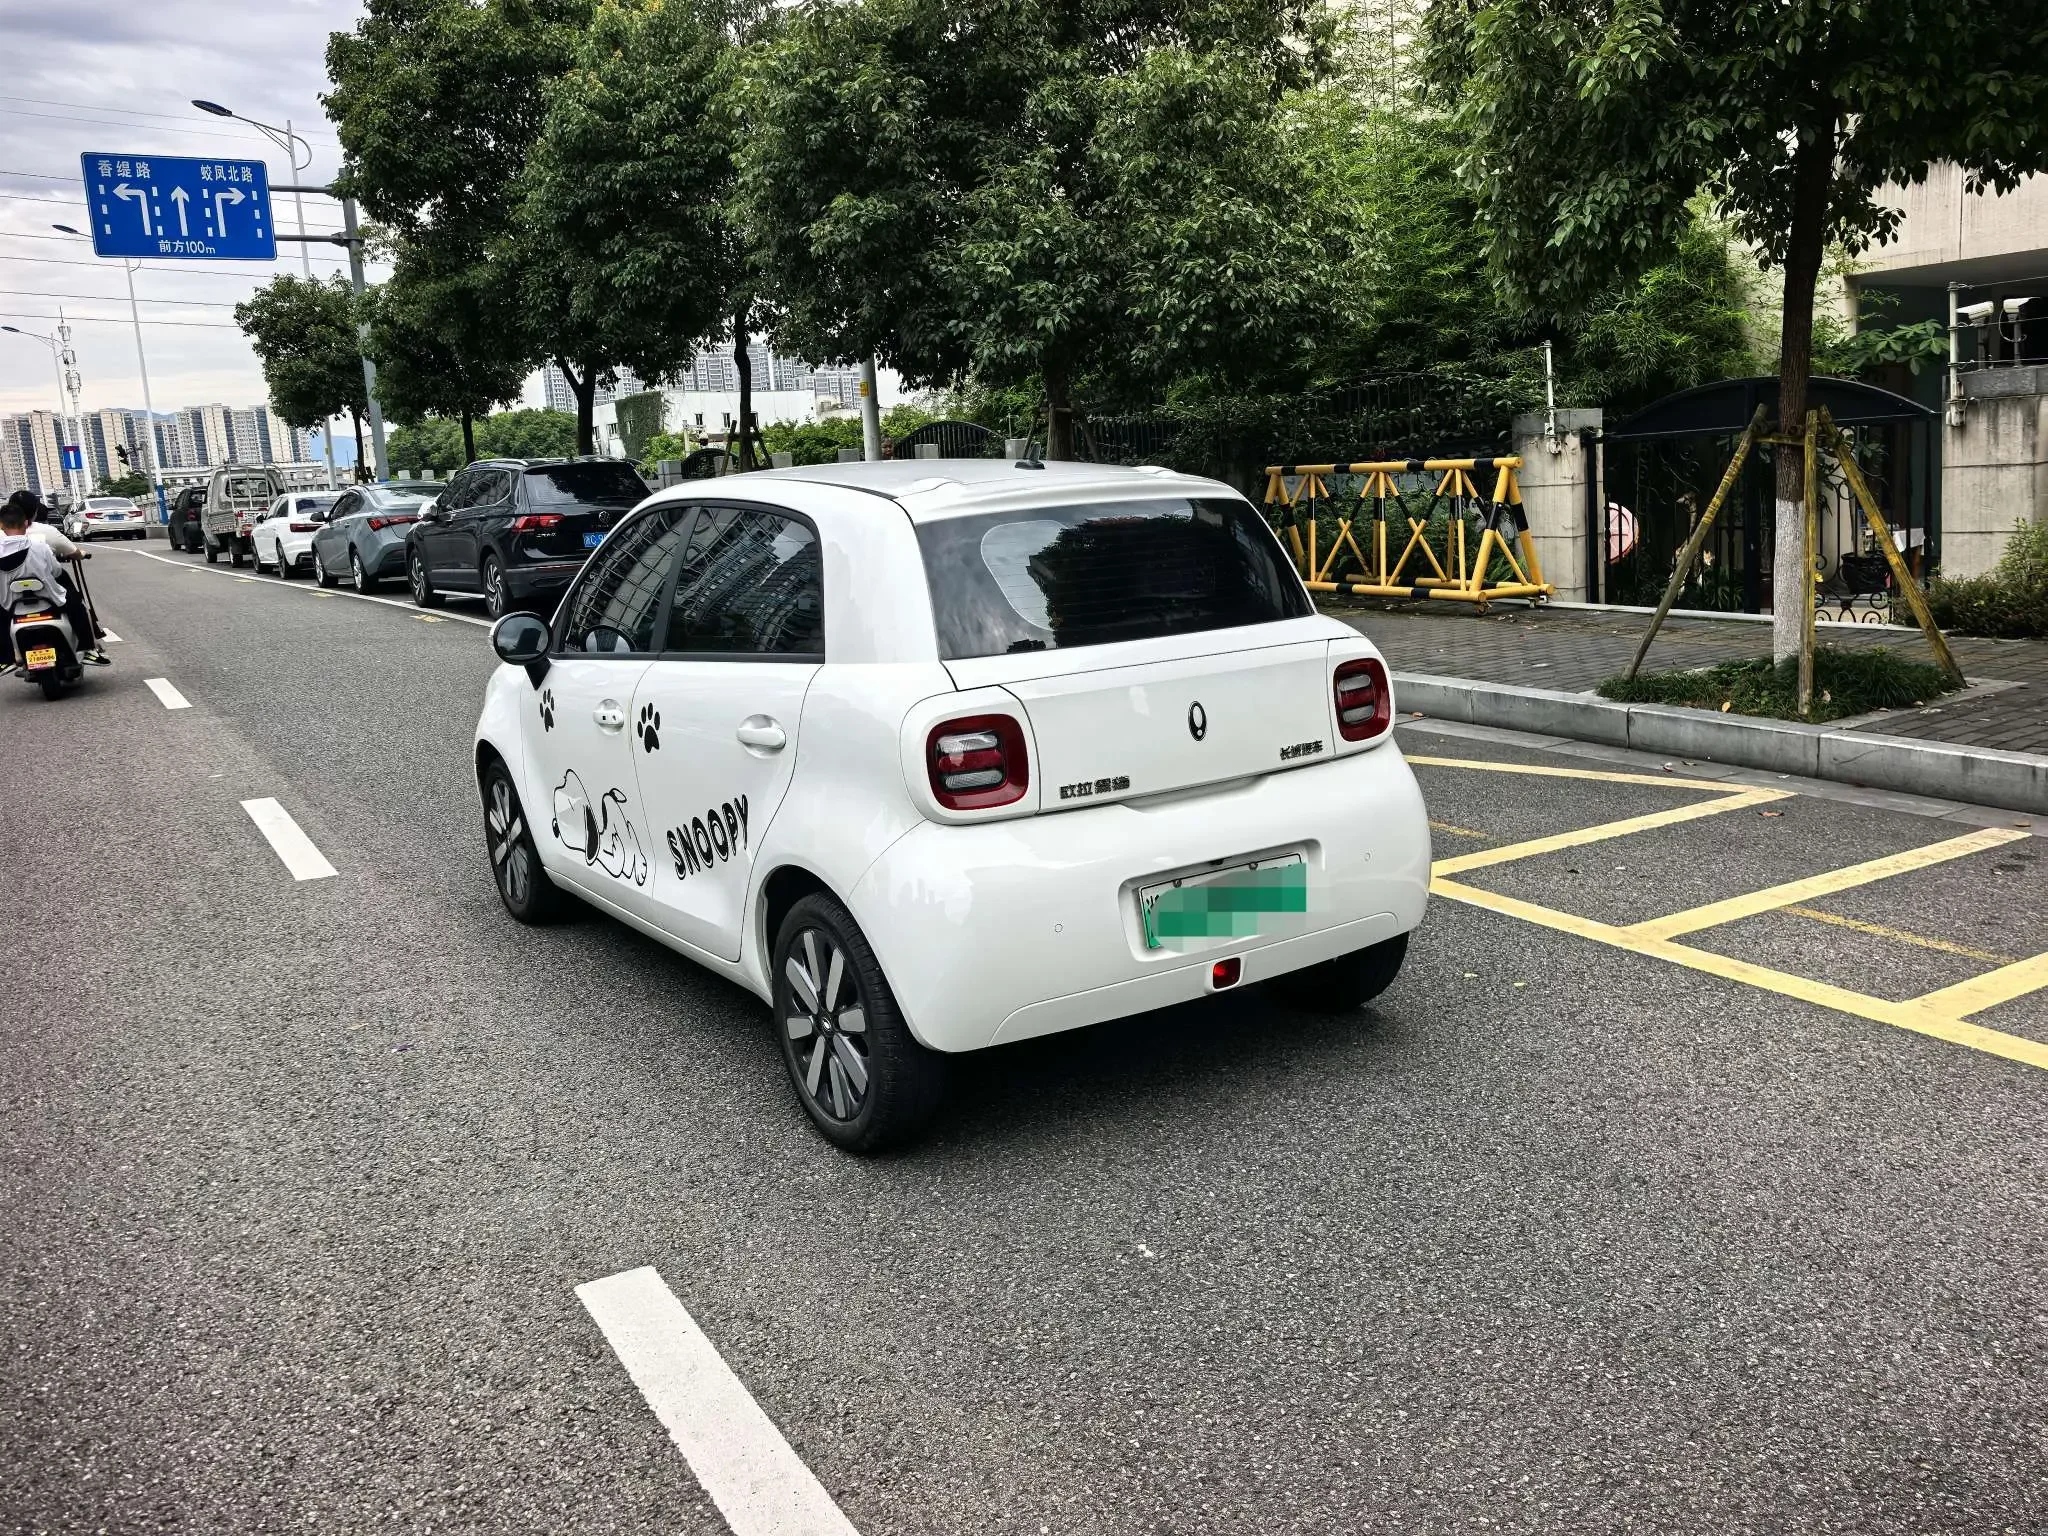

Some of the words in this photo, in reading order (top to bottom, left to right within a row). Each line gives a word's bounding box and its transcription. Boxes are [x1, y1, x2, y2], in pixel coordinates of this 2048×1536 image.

[97, 160, 151, 179] 香缇路
[200, 164, 253, 183] 蛟凤北路
[158, 239, 216, 255] 前方100m
[666, 794, 748, 880] SNOOPY
